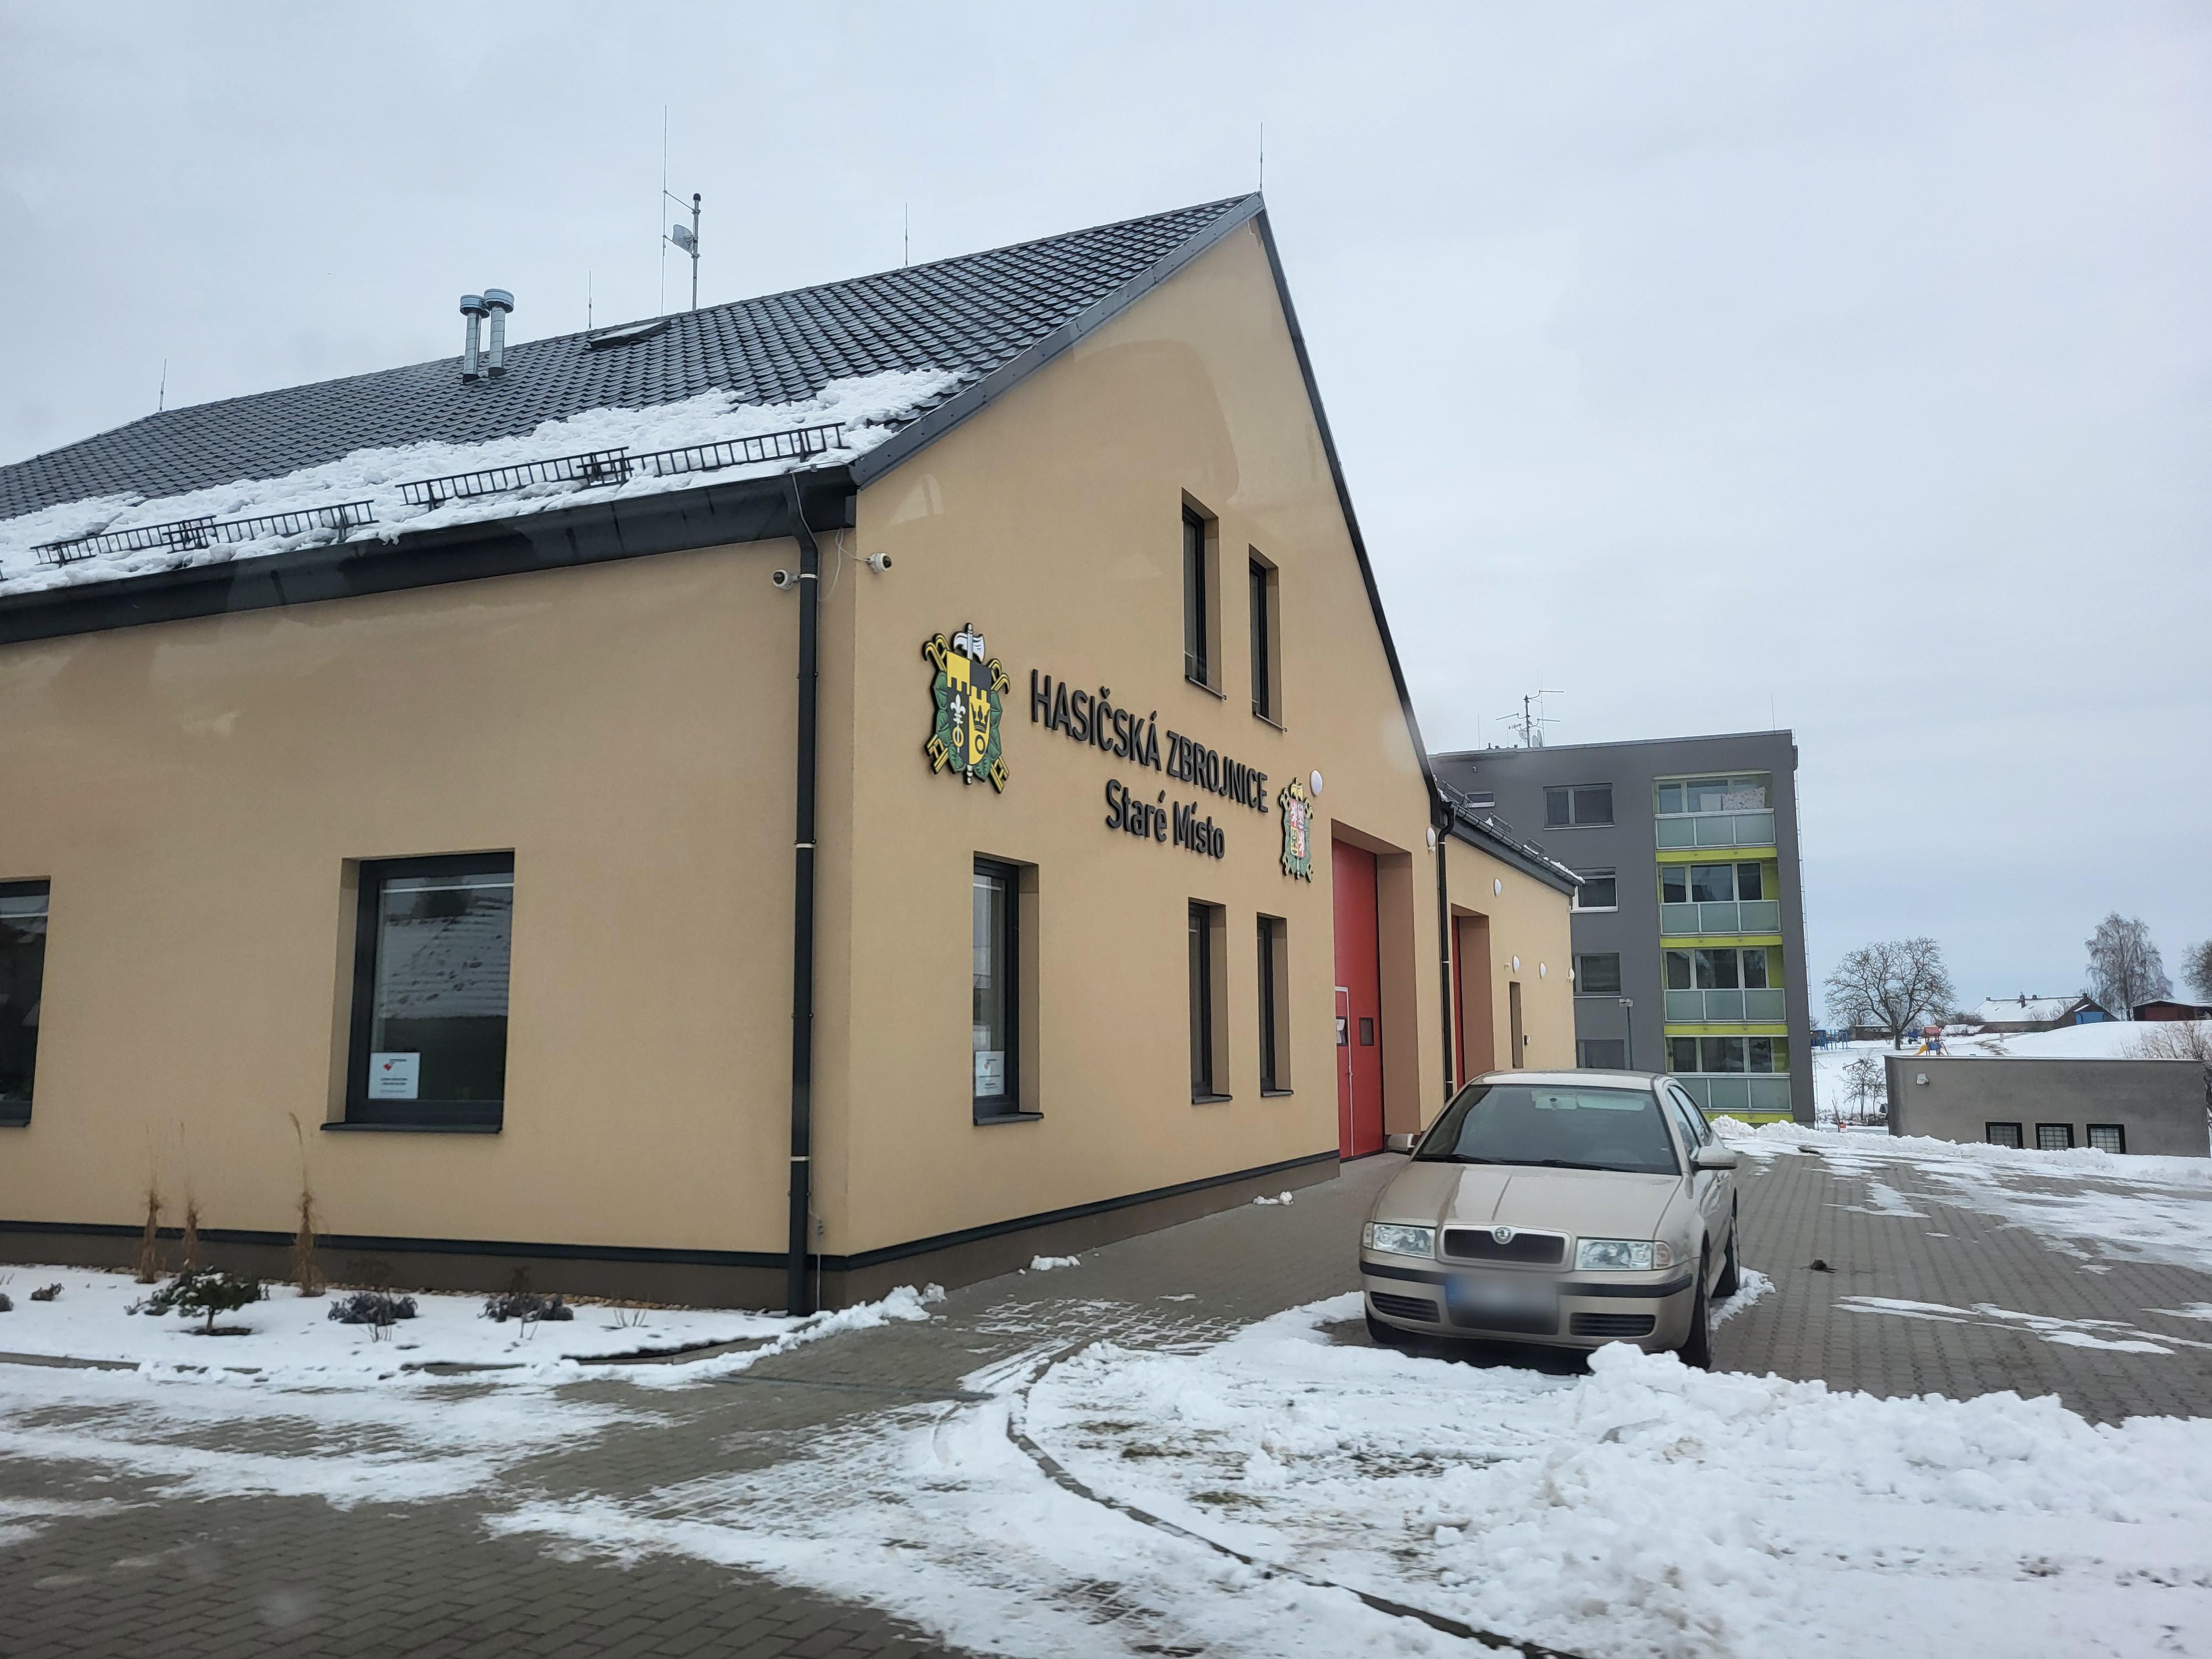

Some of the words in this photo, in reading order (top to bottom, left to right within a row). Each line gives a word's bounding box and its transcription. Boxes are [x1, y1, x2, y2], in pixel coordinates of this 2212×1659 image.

[1031, 669, 1161, 771] HASIČSKÁ
[1167, 730, 1269, 813] ZBROJNICE
[1106, 779, 1167, 842] Staré
[1173, 801, 1225, 859] Místo
